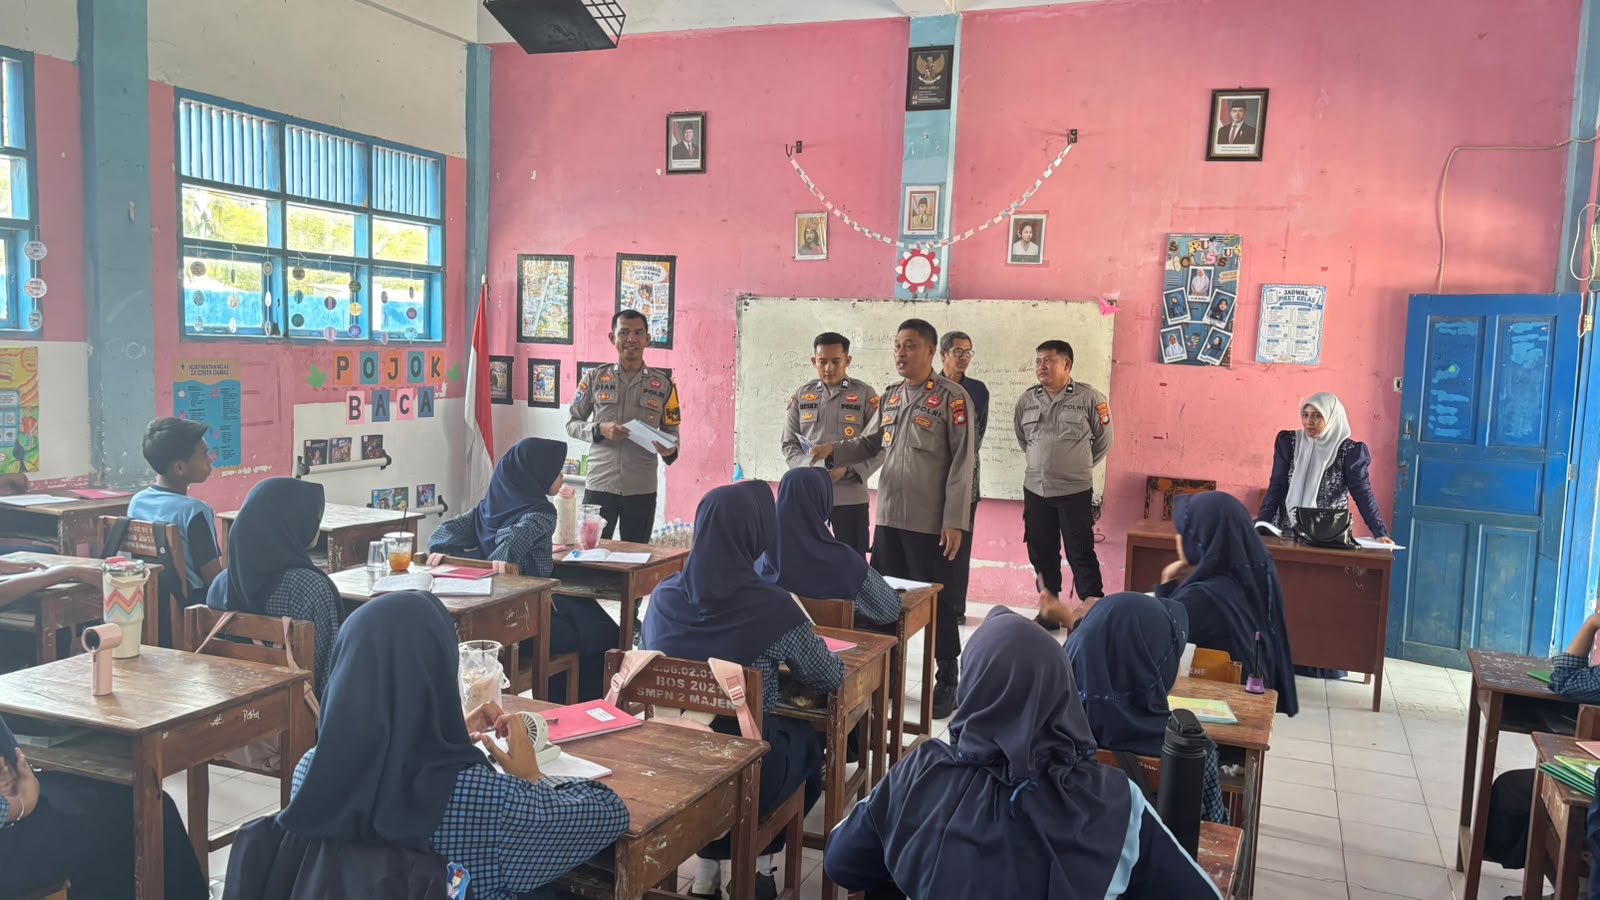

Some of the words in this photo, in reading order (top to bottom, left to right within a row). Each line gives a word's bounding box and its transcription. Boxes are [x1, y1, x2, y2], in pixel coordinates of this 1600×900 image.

[1284, 289, 1309, 297] JADWAL
[1296, 295, 1316, 303] KELAS
[336, 354, 441, 381] POJOK
[595, 383, 616, 392] DIAN
[348, 390, 432, 421] BACA
[914, 404, 942, 418] POLRI
[1062, 403, 1085, 412] POLRI
[656, 675, 685, 689] BOS
[677, 692, 685, 703] 2
[689, 695, 737, 710] MAJEN
